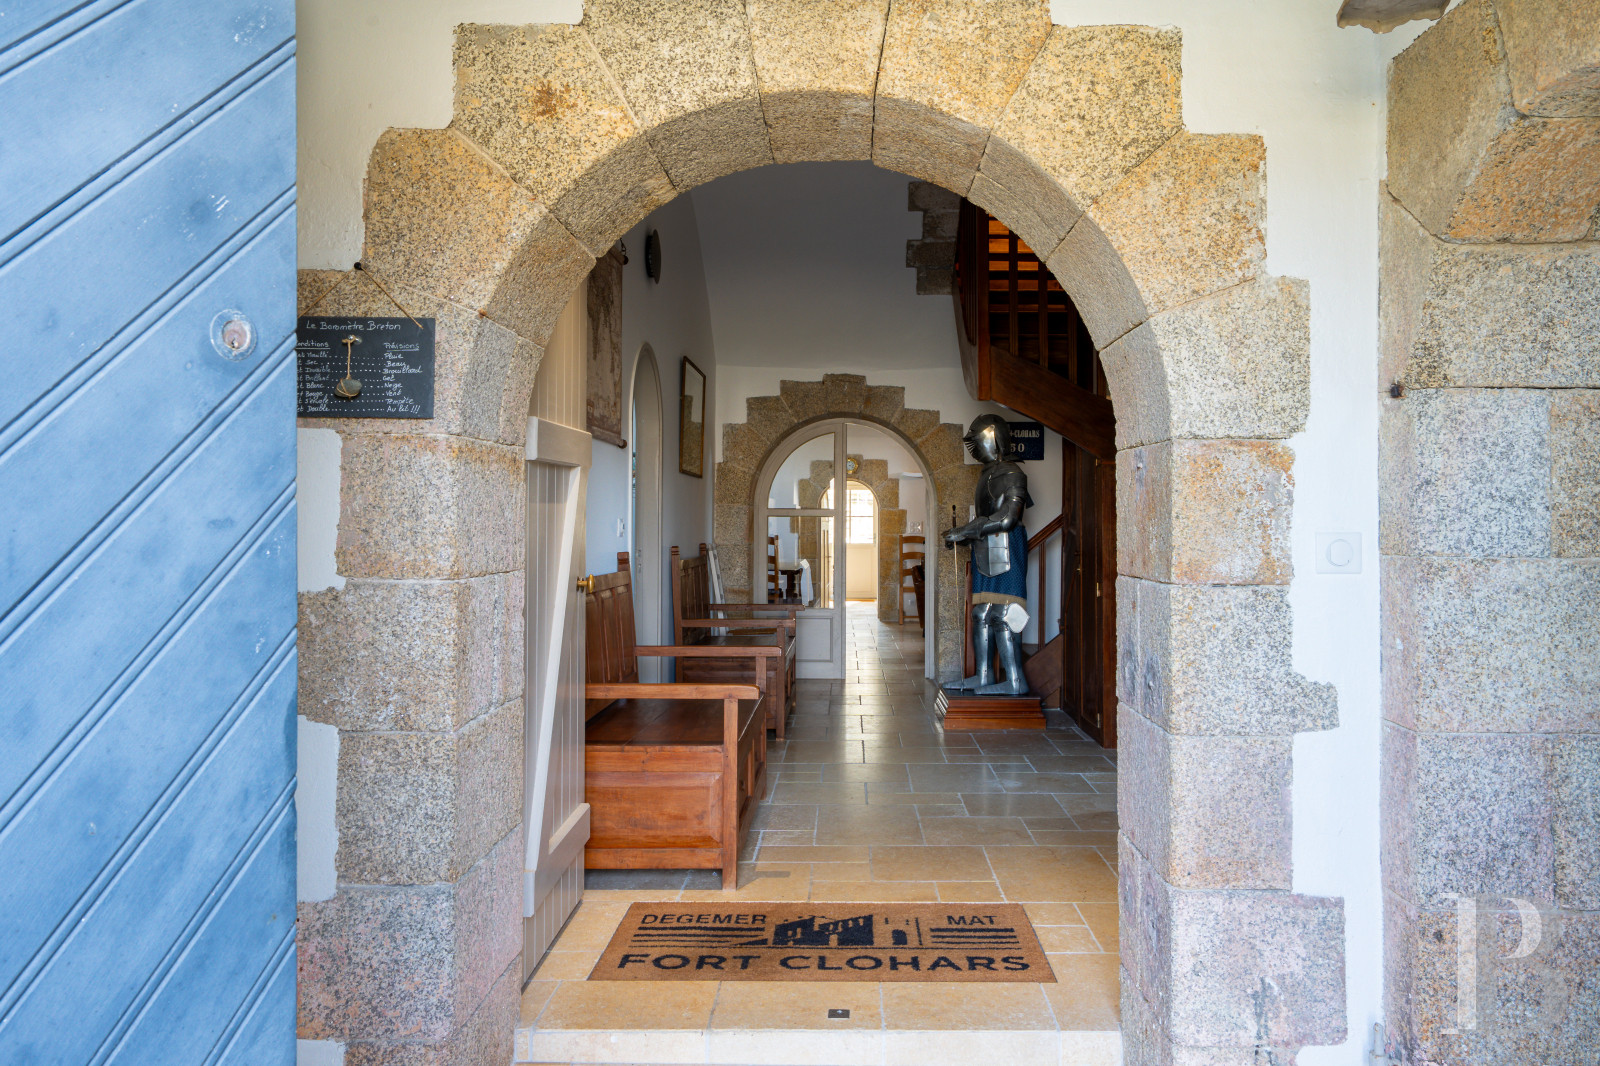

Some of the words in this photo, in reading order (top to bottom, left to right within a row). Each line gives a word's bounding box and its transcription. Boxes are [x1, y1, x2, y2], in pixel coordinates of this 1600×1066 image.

[306, 320, 316, 330] Le
[319, 320, 364, 331] Baromètre
[367, 320, 401, 331] Breton
[307, 404, 329, 412] Double
[641, 914, 767, 925] DEGEMER
[947, 915, 998, 926] MAT
[617, 953, 761, 970] FORT
[779, 955, 1030, 971] CLOHARS
